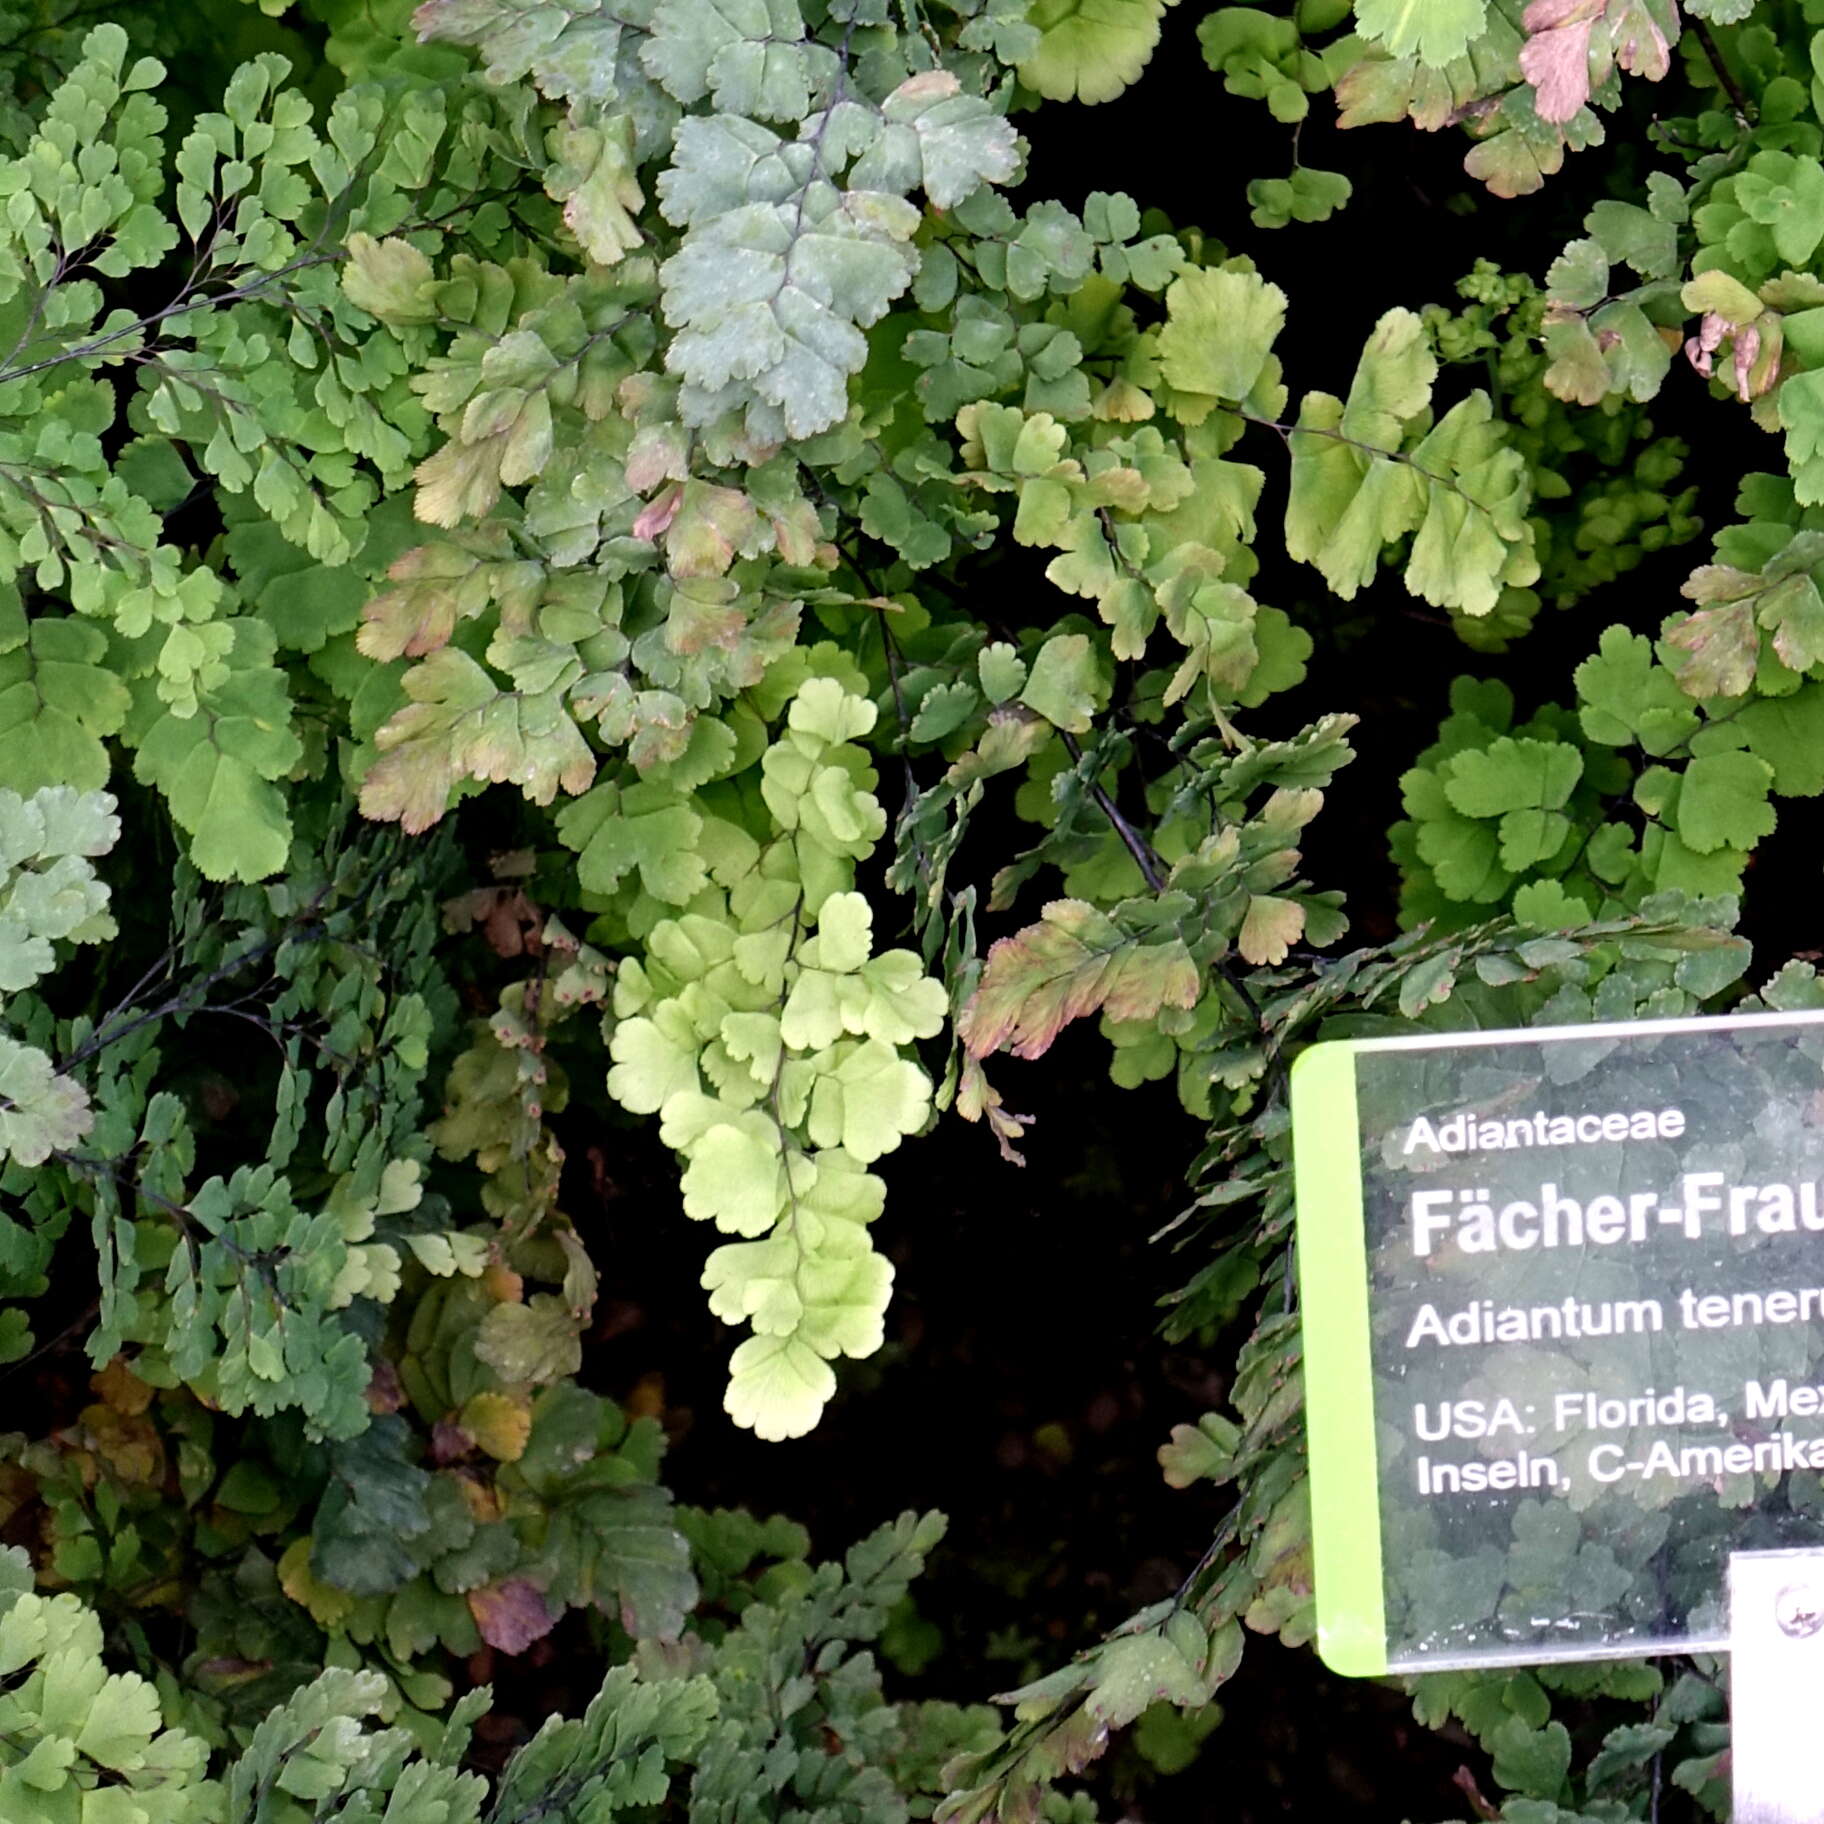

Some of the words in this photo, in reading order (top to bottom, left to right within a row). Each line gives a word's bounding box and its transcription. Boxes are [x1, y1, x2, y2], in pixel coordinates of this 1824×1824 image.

[1404, 1104, 1686, 1154] Adiantaceae
[1406, 1285, 1663, 1348] Adiantum
[1415, 1398, 1536, 1442] USA:
[1554, 1385, 1726, 1433] Florida,
[1418, 1449, 1571, 1495] Inseln,
